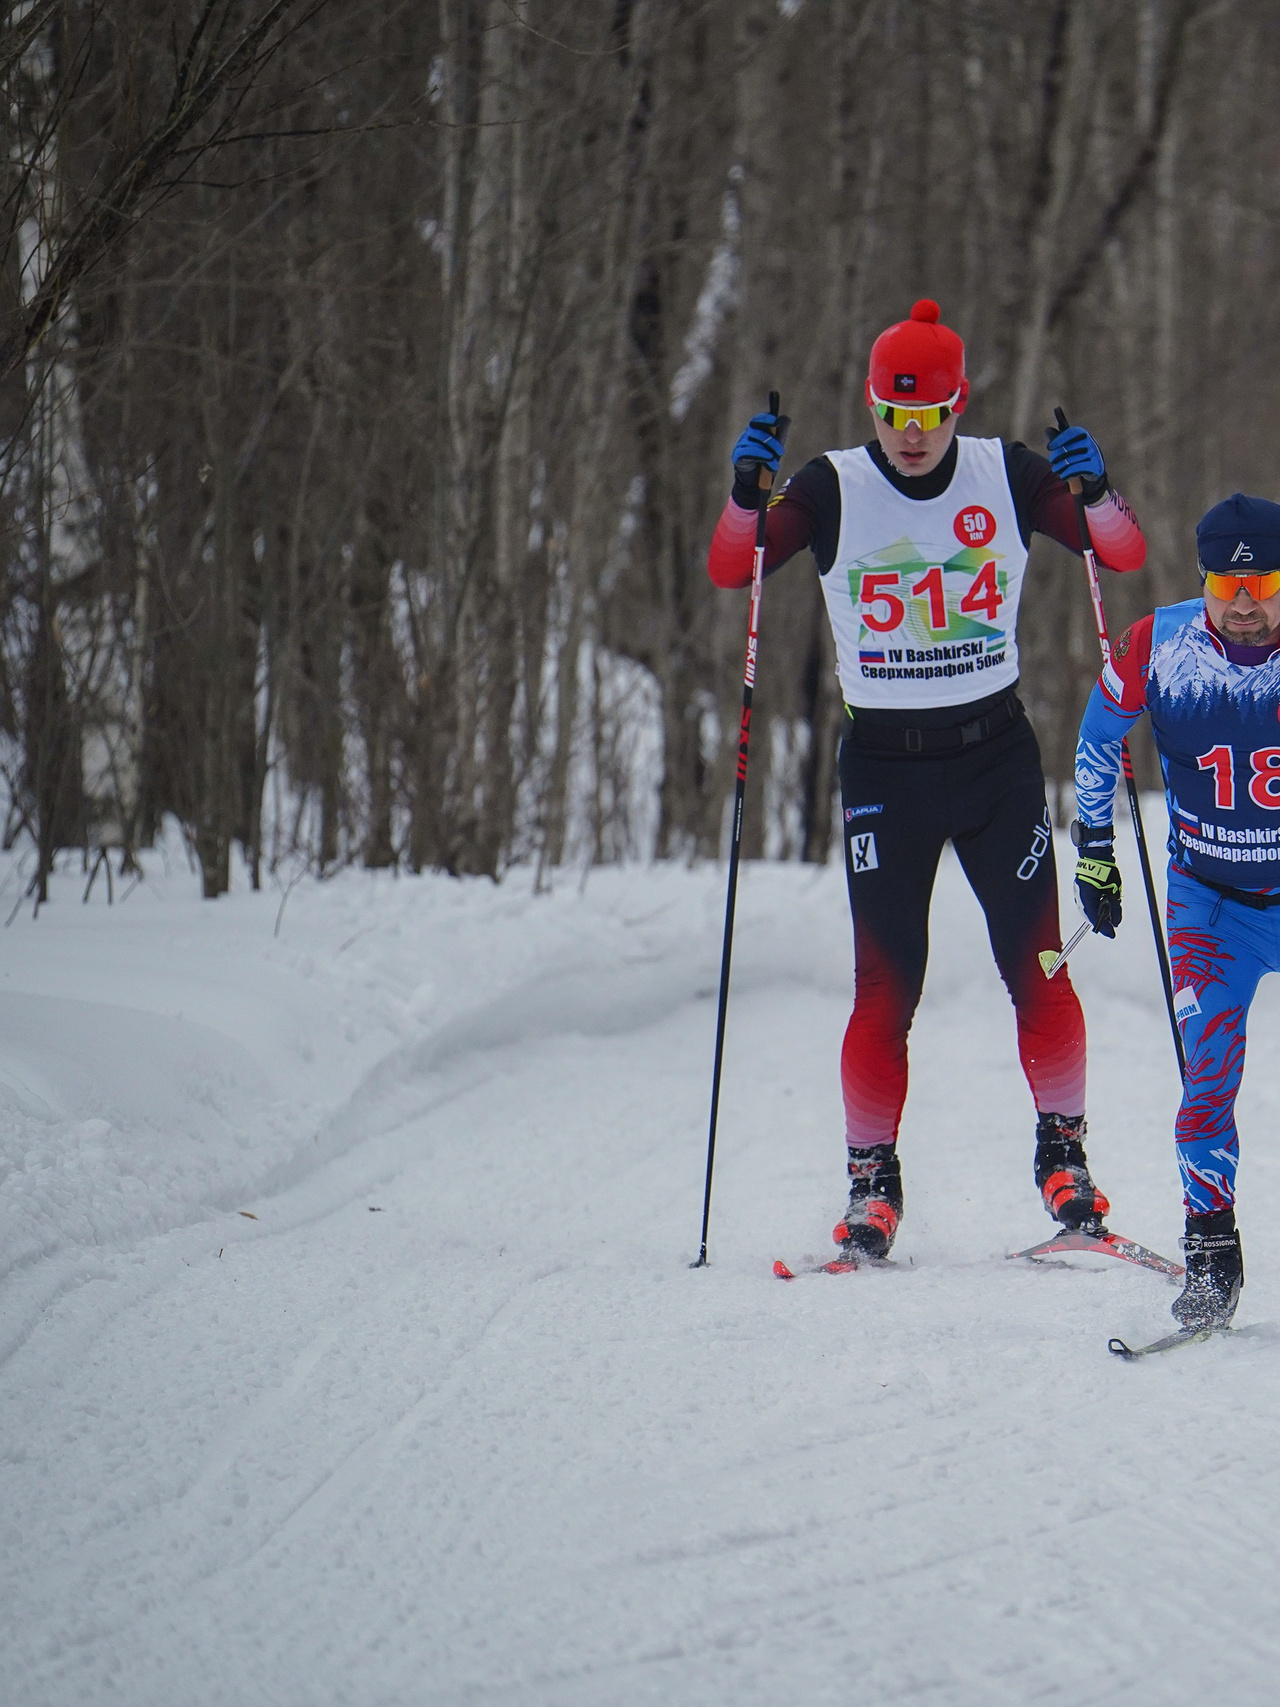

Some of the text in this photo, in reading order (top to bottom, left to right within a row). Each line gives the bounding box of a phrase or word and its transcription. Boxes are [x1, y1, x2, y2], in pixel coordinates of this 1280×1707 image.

[963, 512, 987, 533] 50
[860, 560, 1003, 632] 514
[888, 641, 983, 663] IV BashkirSki
[861, 651, 1006, 680] Сверхмарафон 50км
[1201, 823, 1215, 840] IV
[1204, 1239, 1237, 1248] ROSSIGNOL
